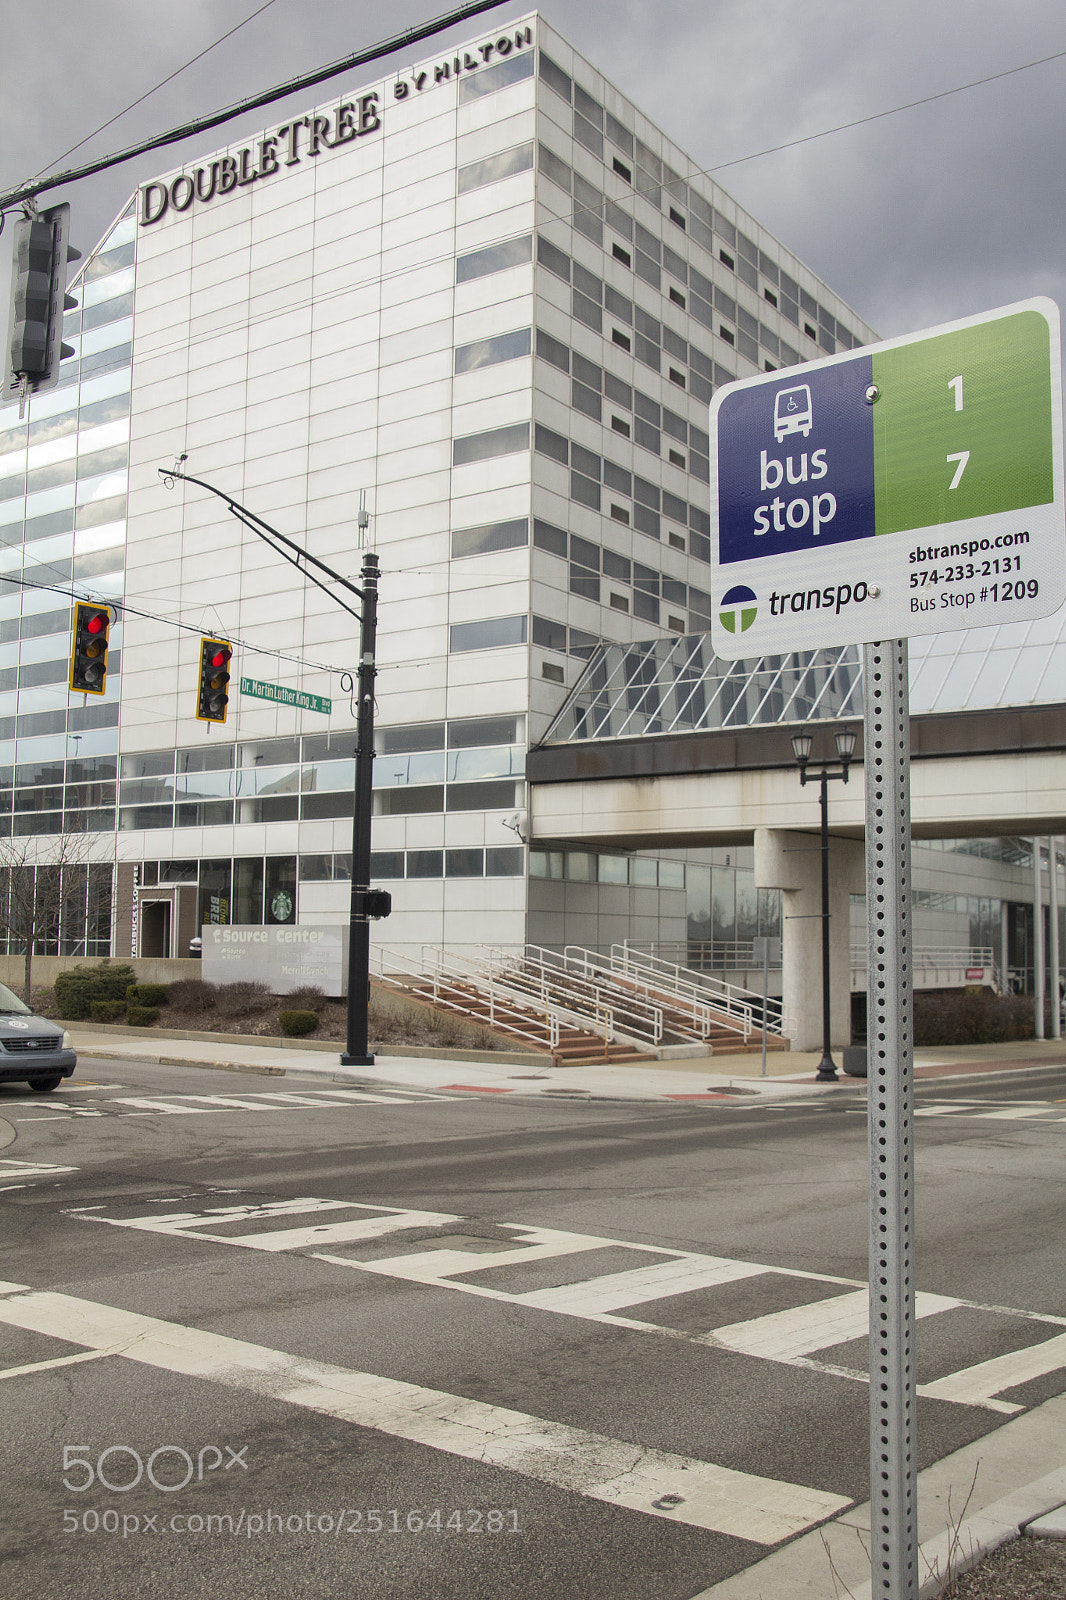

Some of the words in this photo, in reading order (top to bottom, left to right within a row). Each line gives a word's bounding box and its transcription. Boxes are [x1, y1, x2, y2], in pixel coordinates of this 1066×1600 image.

[394, 72, 426, 100] BY
[434, 26, 531, 83] HILTON
[948, 375, 963, 411] 1
[760, 449, 828, 490] bus
[947, 451, 970, 489] 7
[753, 492, 837, 535] stop
[909, 531, 1030, 563] sbtranspo.com
[909, 555, 1021, 588] 574-233-2131
[769, 581, 868, 615] transpo
[910, 597, 936, 612] Bus
[940, 592, 975, 608] Stop
[980, 579, 1039, 602] #1209
[241, 678, 251, 692] Dr.
[252, 681, 273, 698] Martin
[274, 686, 295, 703] Luther
[296, 692, 309, 709] King
[223, 929, 268, 943] Source
[276, 929, 325, 943] Center
